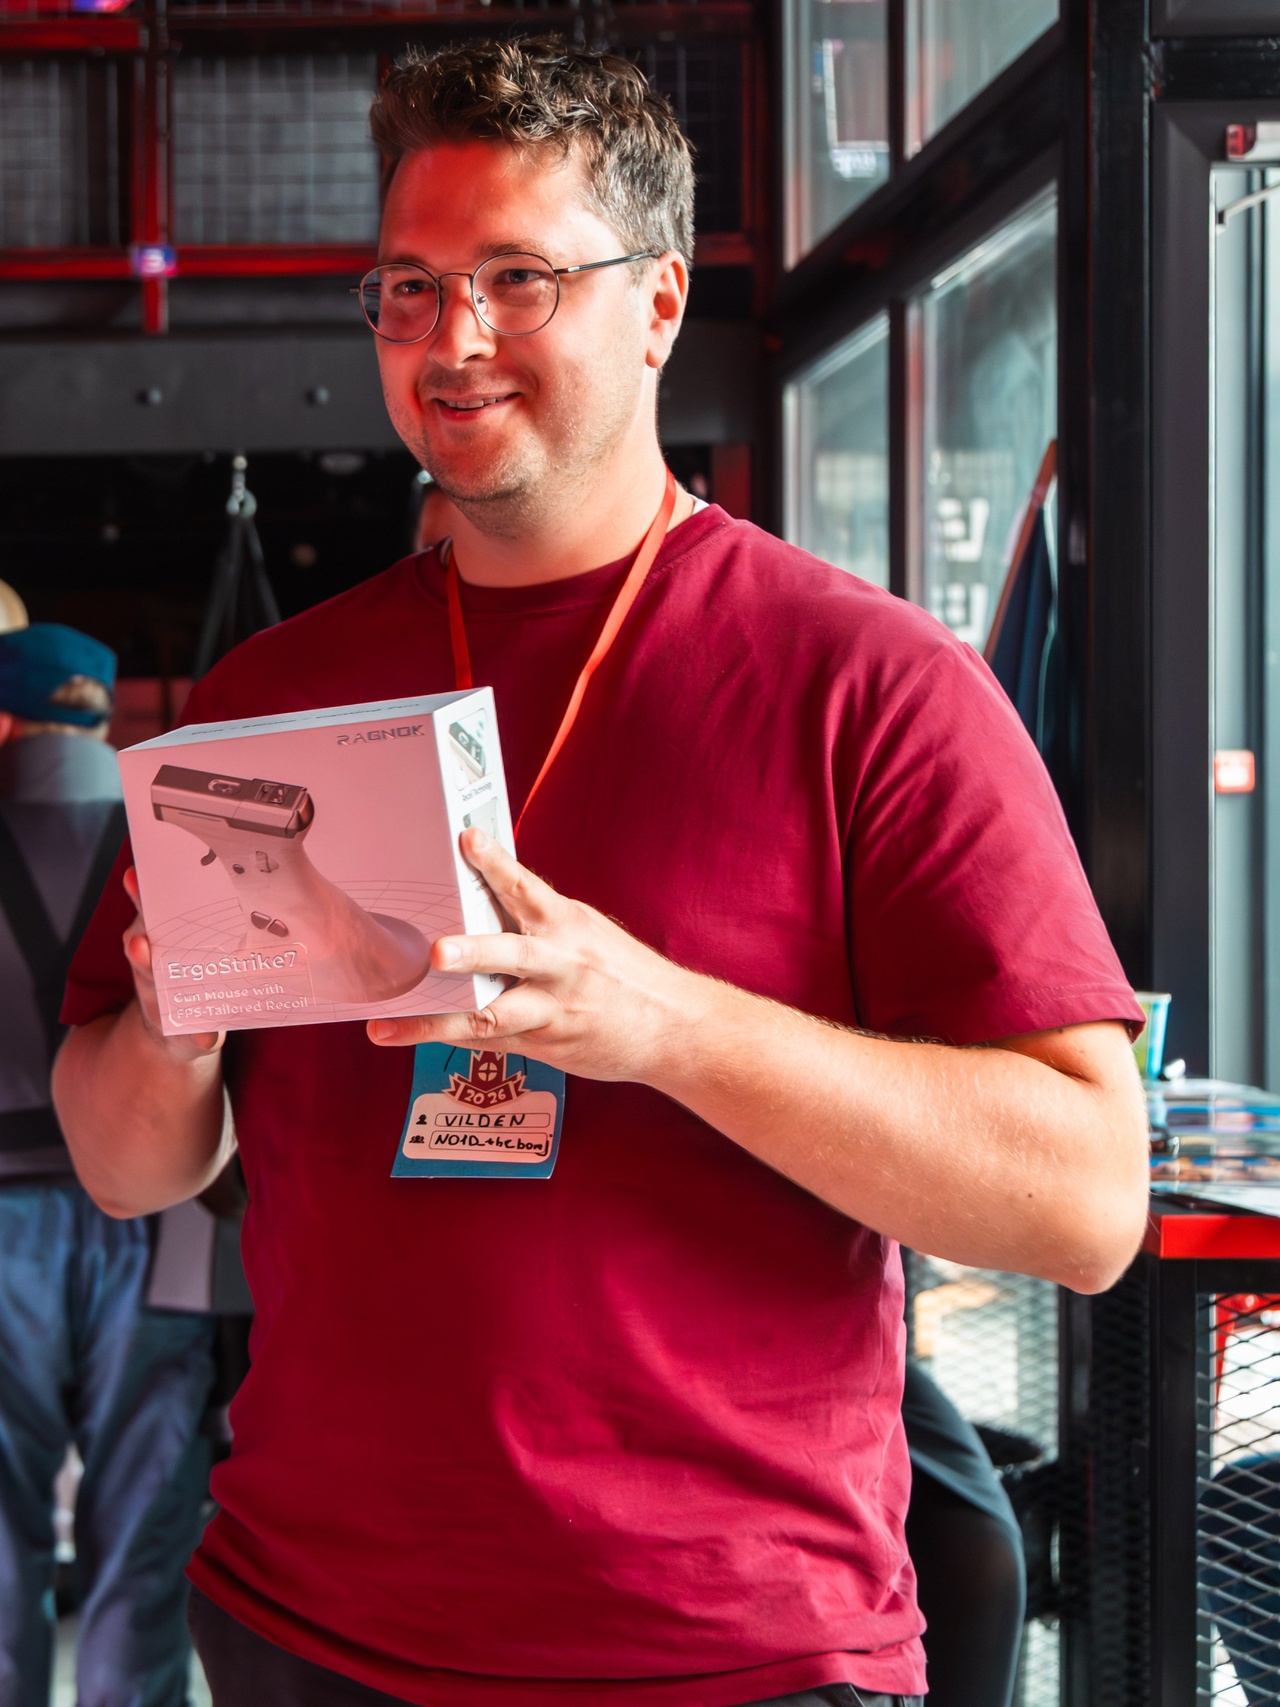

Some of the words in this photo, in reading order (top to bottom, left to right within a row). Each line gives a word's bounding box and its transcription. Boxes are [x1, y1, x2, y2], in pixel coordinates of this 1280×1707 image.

[336, 724, 425, 746] RAGNOK
[167, 950, 297, 981] ErgoStrike7
[204, 988, 249, 1001] Mouse
[252, 983, 284, 996] with
[265, 996, 309, 1011] Recoil
